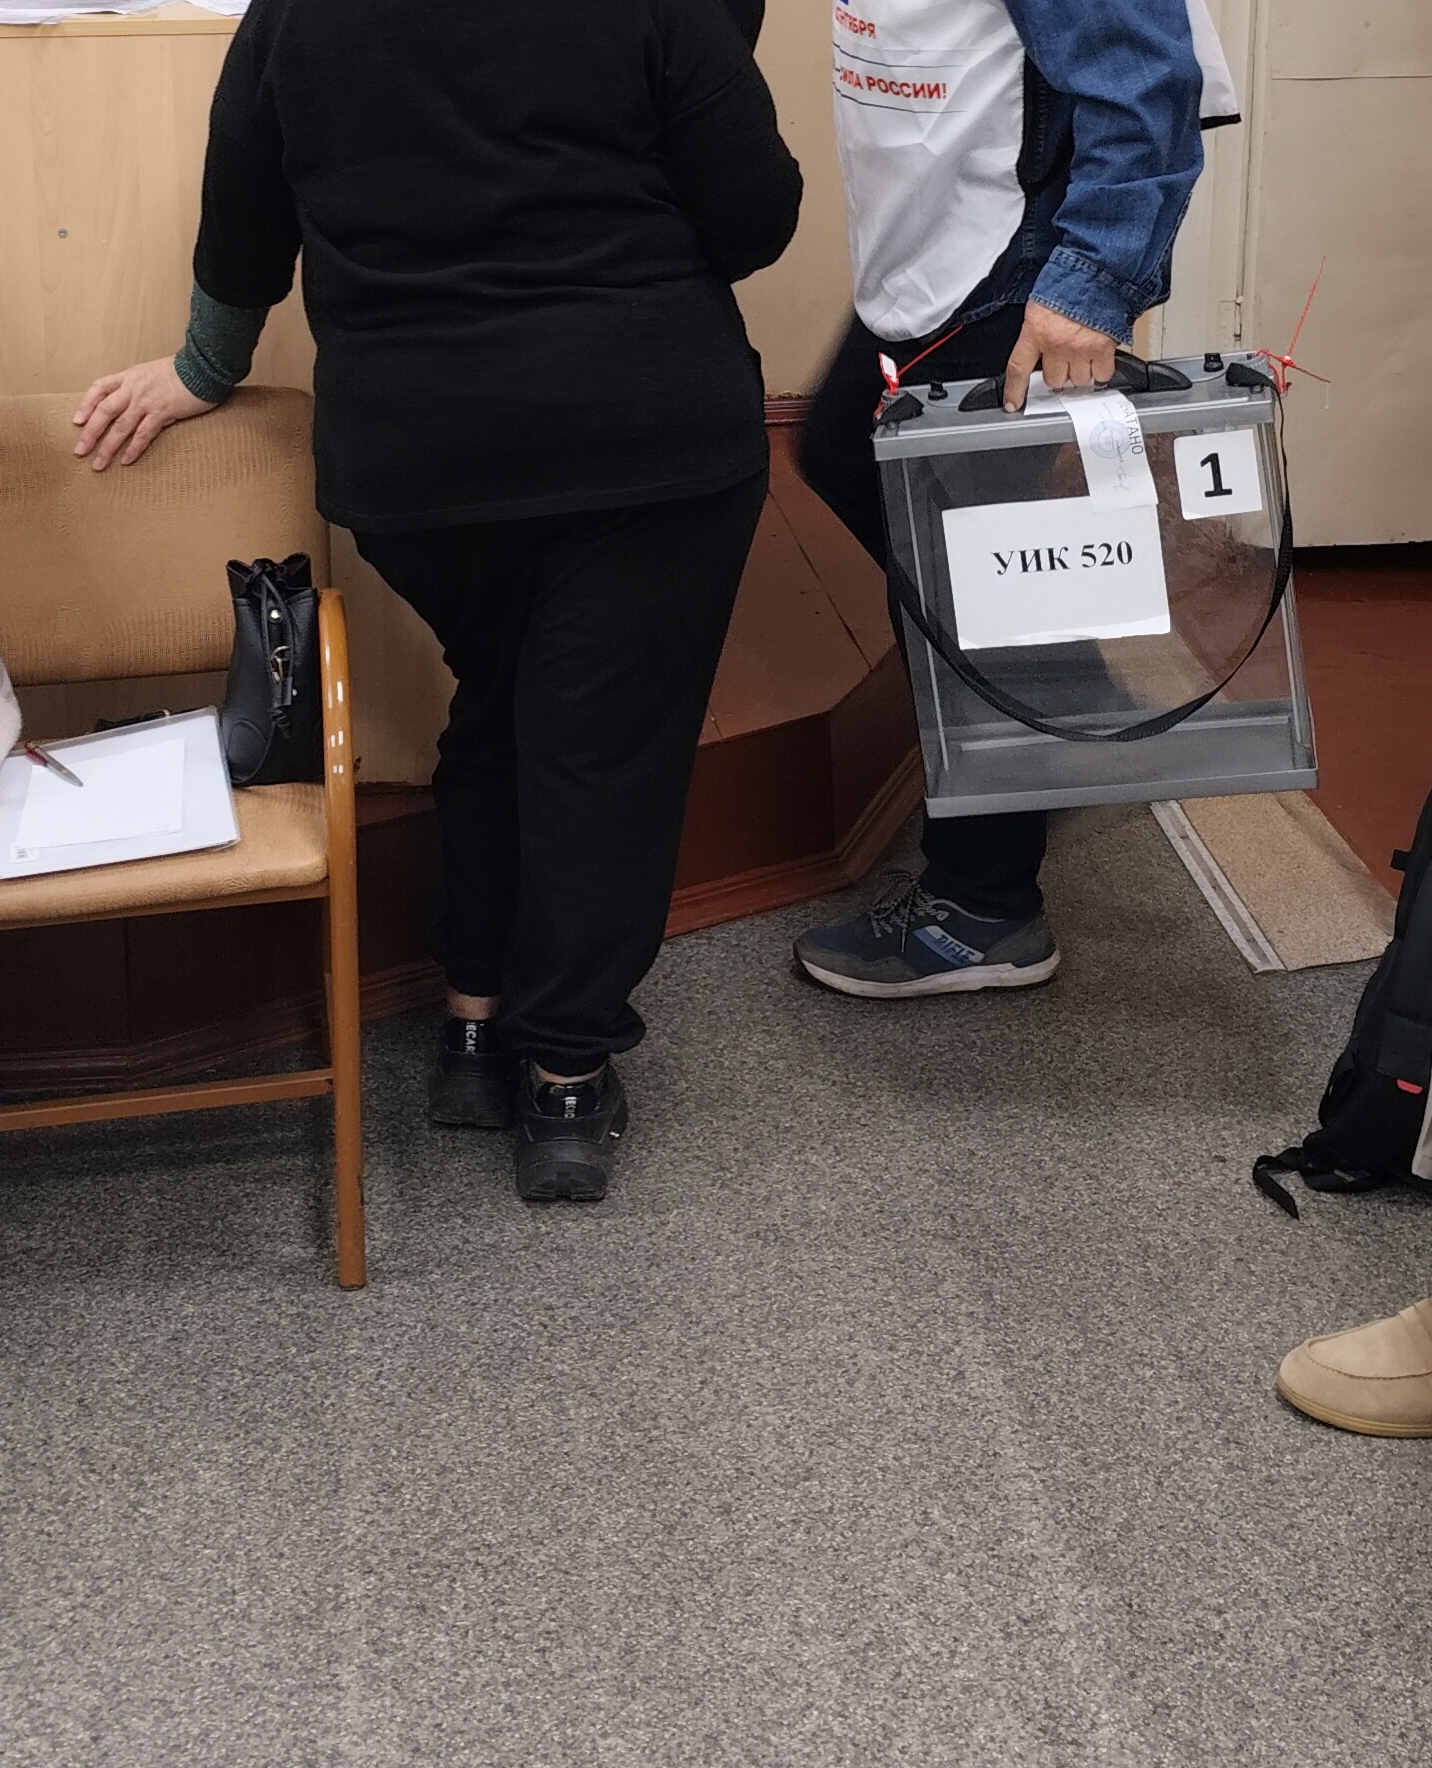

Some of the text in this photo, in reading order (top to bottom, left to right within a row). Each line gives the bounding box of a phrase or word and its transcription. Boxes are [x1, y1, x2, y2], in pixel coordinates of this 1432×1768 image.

[865, 75, 947, 99] РОССИИ!
[1199, 452, 1233, 498] 1
[990, 540, 1133, 576] УИК 520
